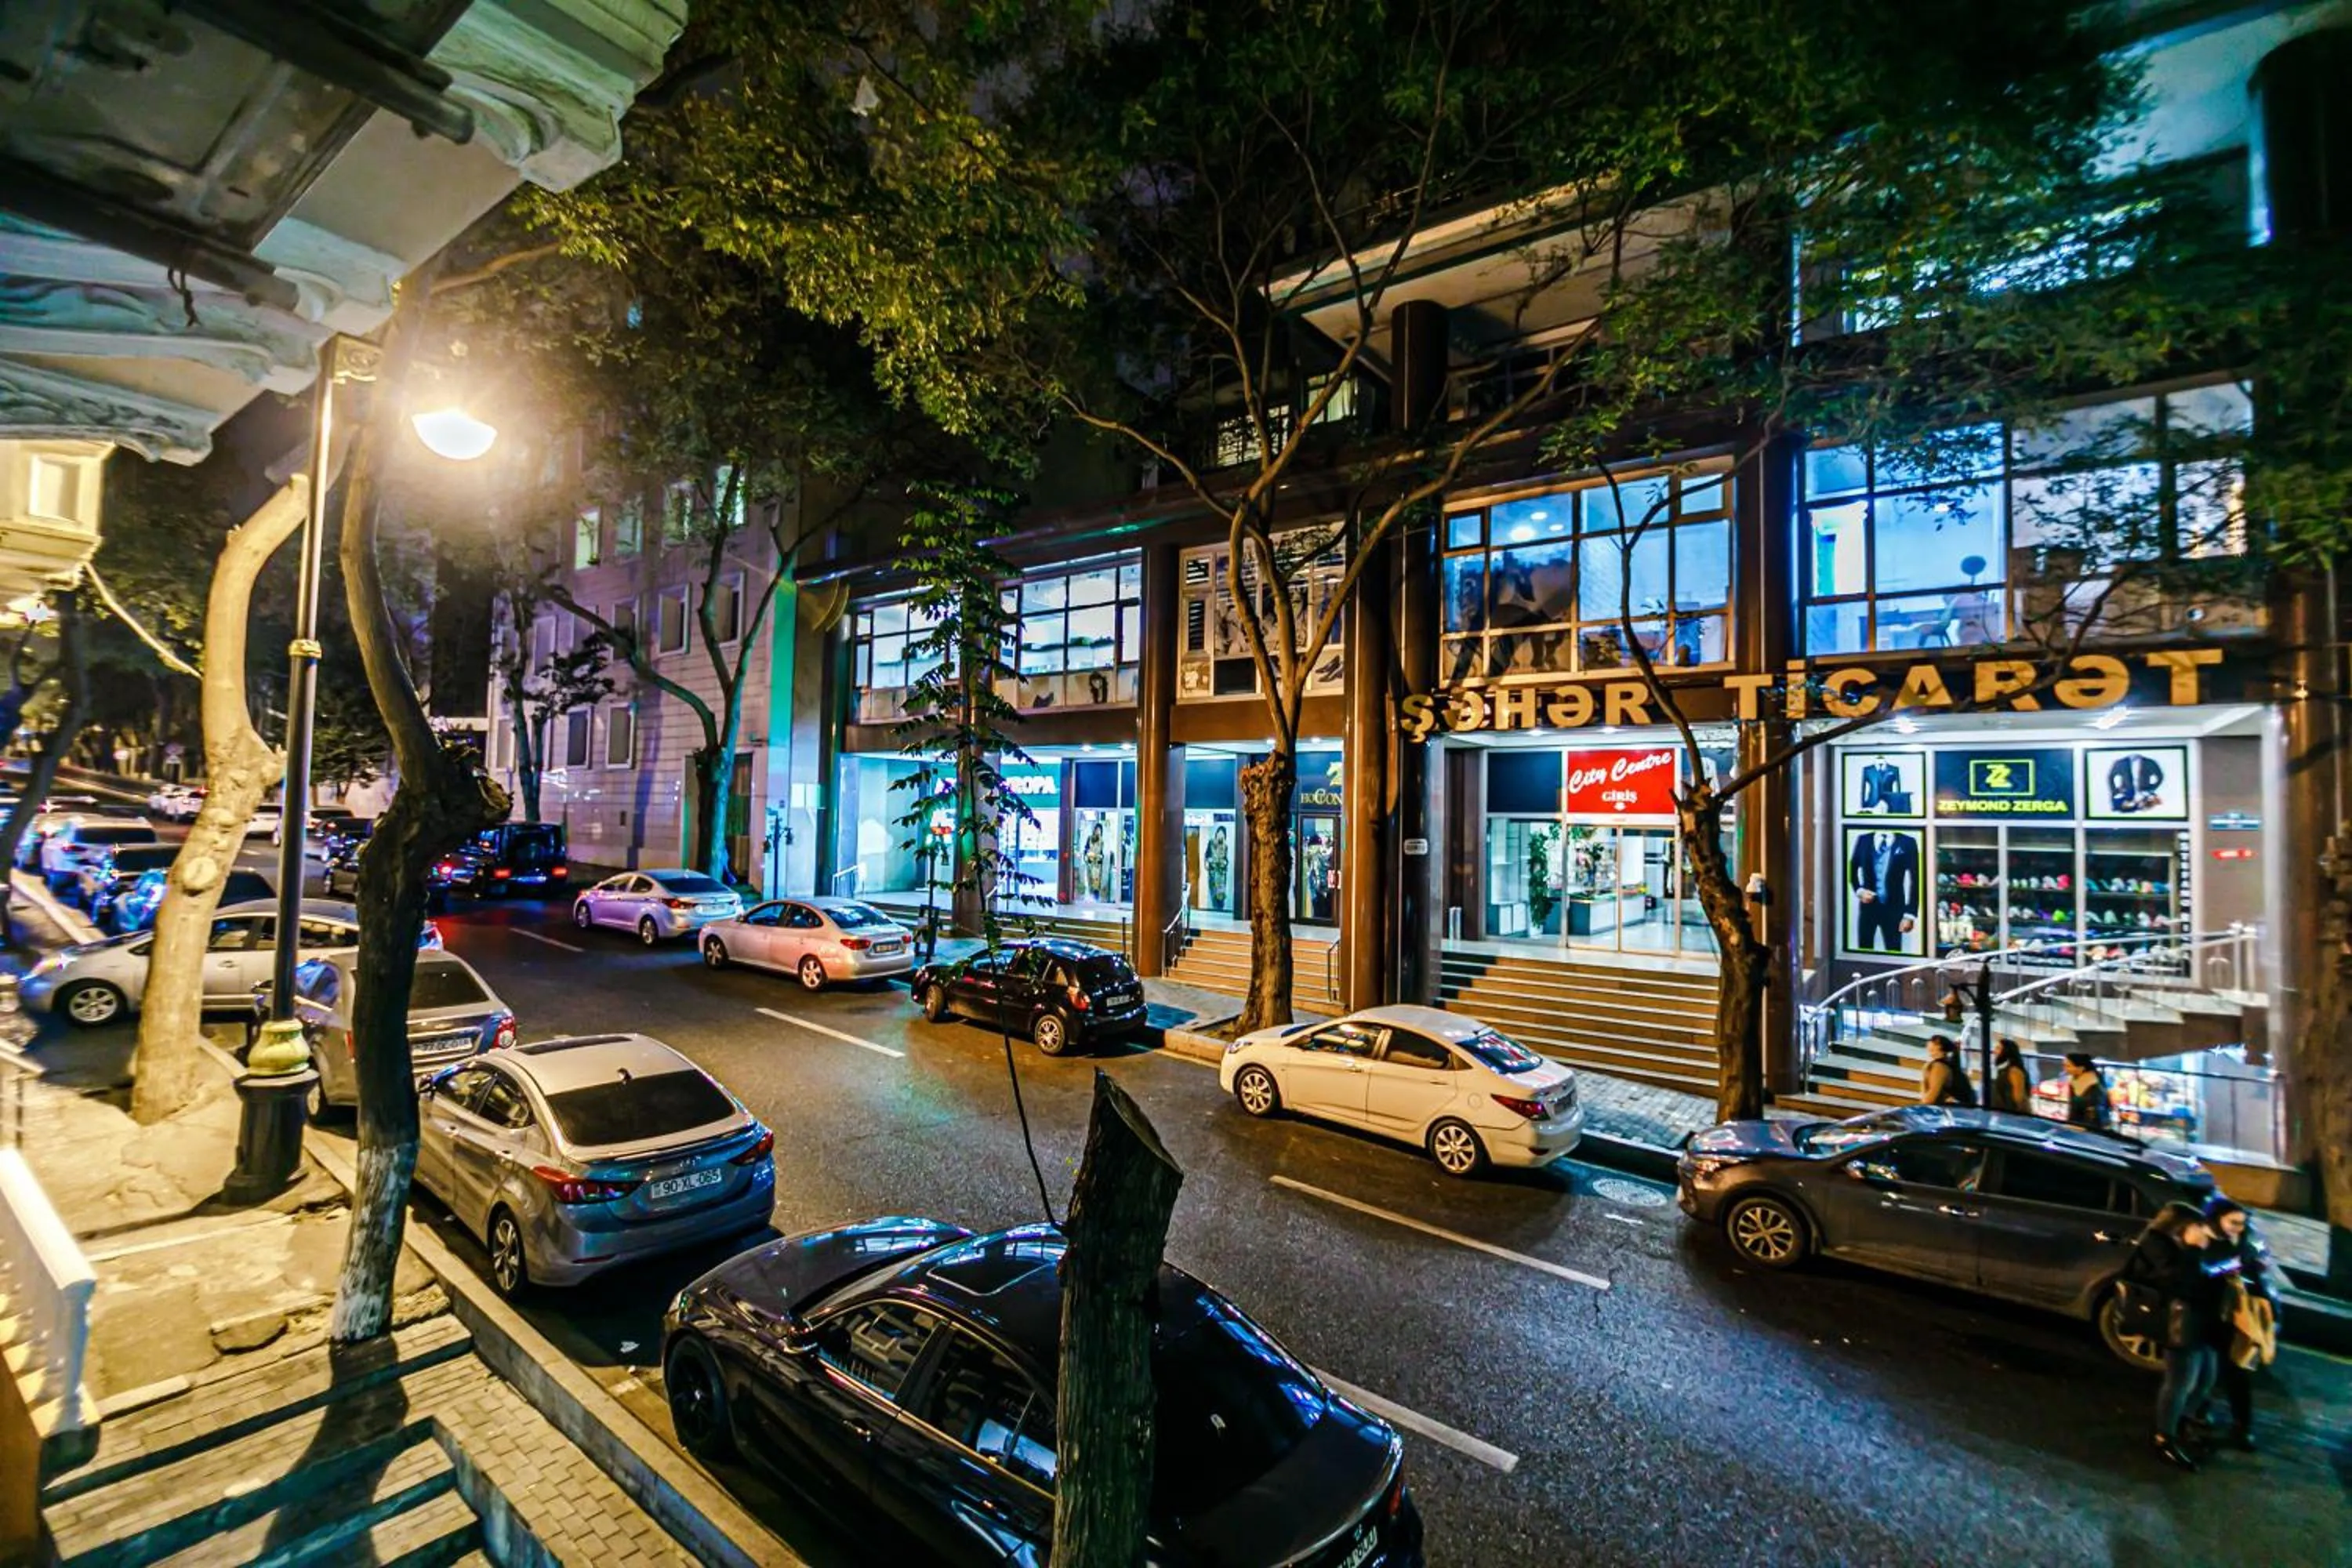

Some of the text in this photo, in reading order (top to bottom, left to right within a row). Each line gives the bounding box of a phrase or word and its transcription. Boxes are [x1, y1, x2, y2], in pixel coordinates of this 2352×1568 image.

[1401, 648, 2223, 742] ŞƏHƏR TİCARƏT
[1569, 752, 1671, 793] City Centre
[1936, 800, 2069, 812] ZEYMOND ZERGA
